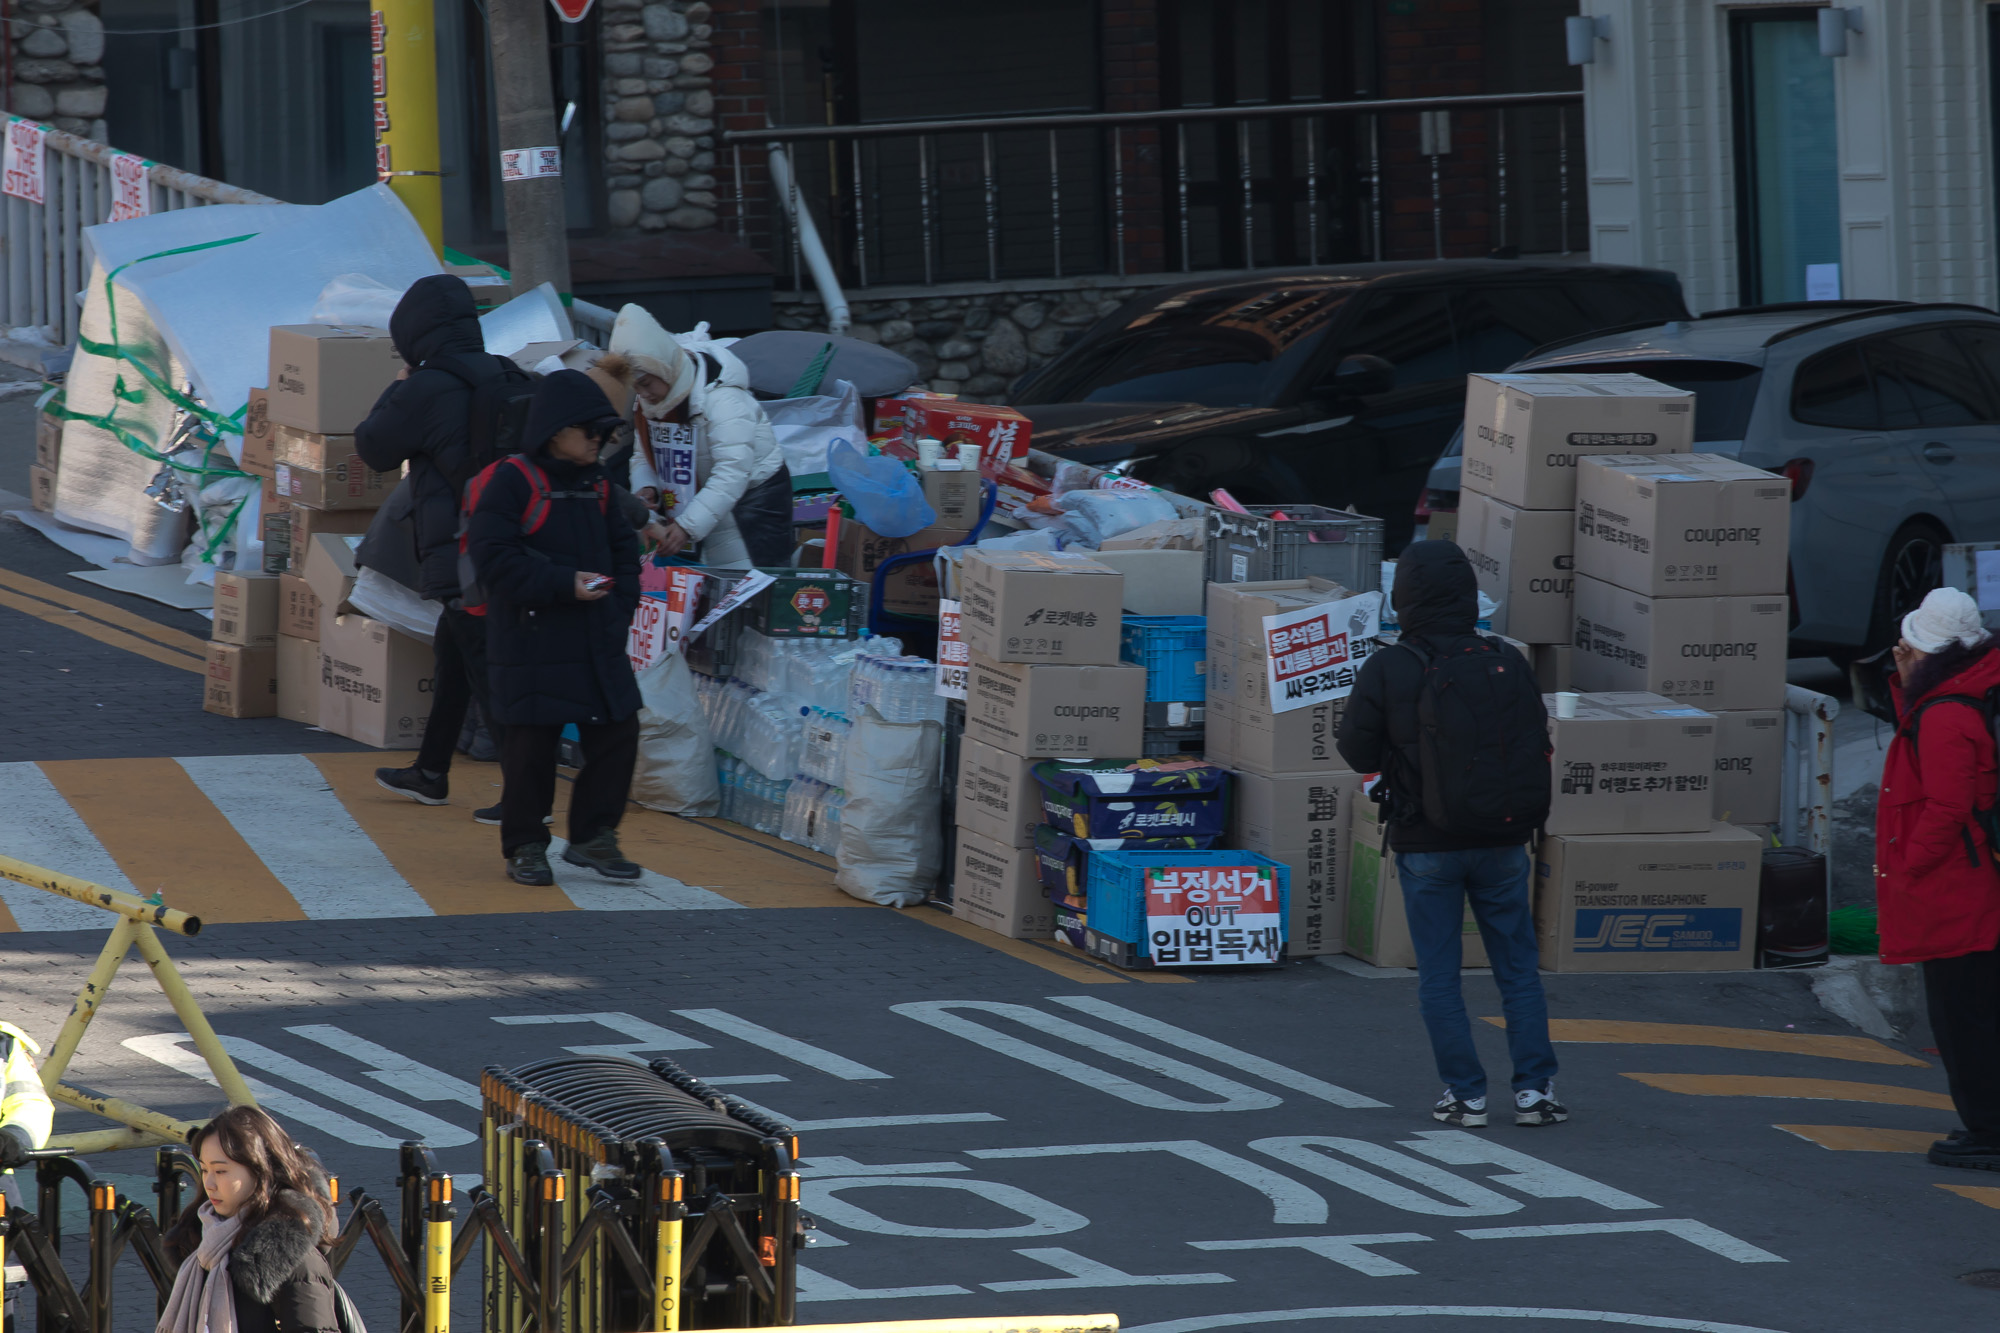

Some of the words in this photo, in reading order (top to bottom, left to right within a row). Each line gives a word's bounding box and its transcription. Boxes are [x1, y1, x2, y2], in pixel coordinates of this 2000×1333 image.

[11, 124, 39, 150] STOP
[15, 147, 37, 175] THE
[503, 153, 520, 162] STOP
[505, 161, 518, 169] THE
[540, 150, 557, 158] STOP
[543, 157, 557, 165] THE
[114, 156, 143, 183] STOP
[503, 168, 524, 177] STEAL
[539, 165, 559, 173] STEAL
[6, 169, 42, 201] STEAL
[119, 179, 141, 208] THE
[947, 421, 982, 433] 초코파이
[1477, 424, 1515, 454] coupang
[987, 420, 1020, 463] 情
[1685, 526, 1761, 547] coupang
[630, 602, 659, 631] TOP
[1043, 610, 1098, 627] 로켓배송
[631, 628, 653, 660] THE
[1271, 619, 1326, 654] 윤석열
[1275, 637, 1348, 676] 대통령과
[1681, 641, 1758, 661] coupang
[1054, 705, 1120, 722] coupang
[1312, 705, 1330, 761] travel
[1599, 776, 1642, 794] 여행도
[1643, 776, 1673, 793] 추가
[1674, 774, 1709, 793] 할인!
[1133, 812, 1196, 827] 로켓프레시
[1307, 829, 1323, 876] 여행도
[1150, 869, 1273, 904] 부정선거
[1307, 878, 1323, 910] 추가
[1574, 881, 1619, 894] Hi-power
[1574, 895, 1638, 906] TRANSISTOR
[1641, 894, 1708, 906] MEGAPHONE
[1186, 905, 1242, 927] OUT
[1151, 926, 1278, 963] 입법독재
[1307, 913, 1323, 951] 할인!
[1573, 914, 1688, 949] JEC
